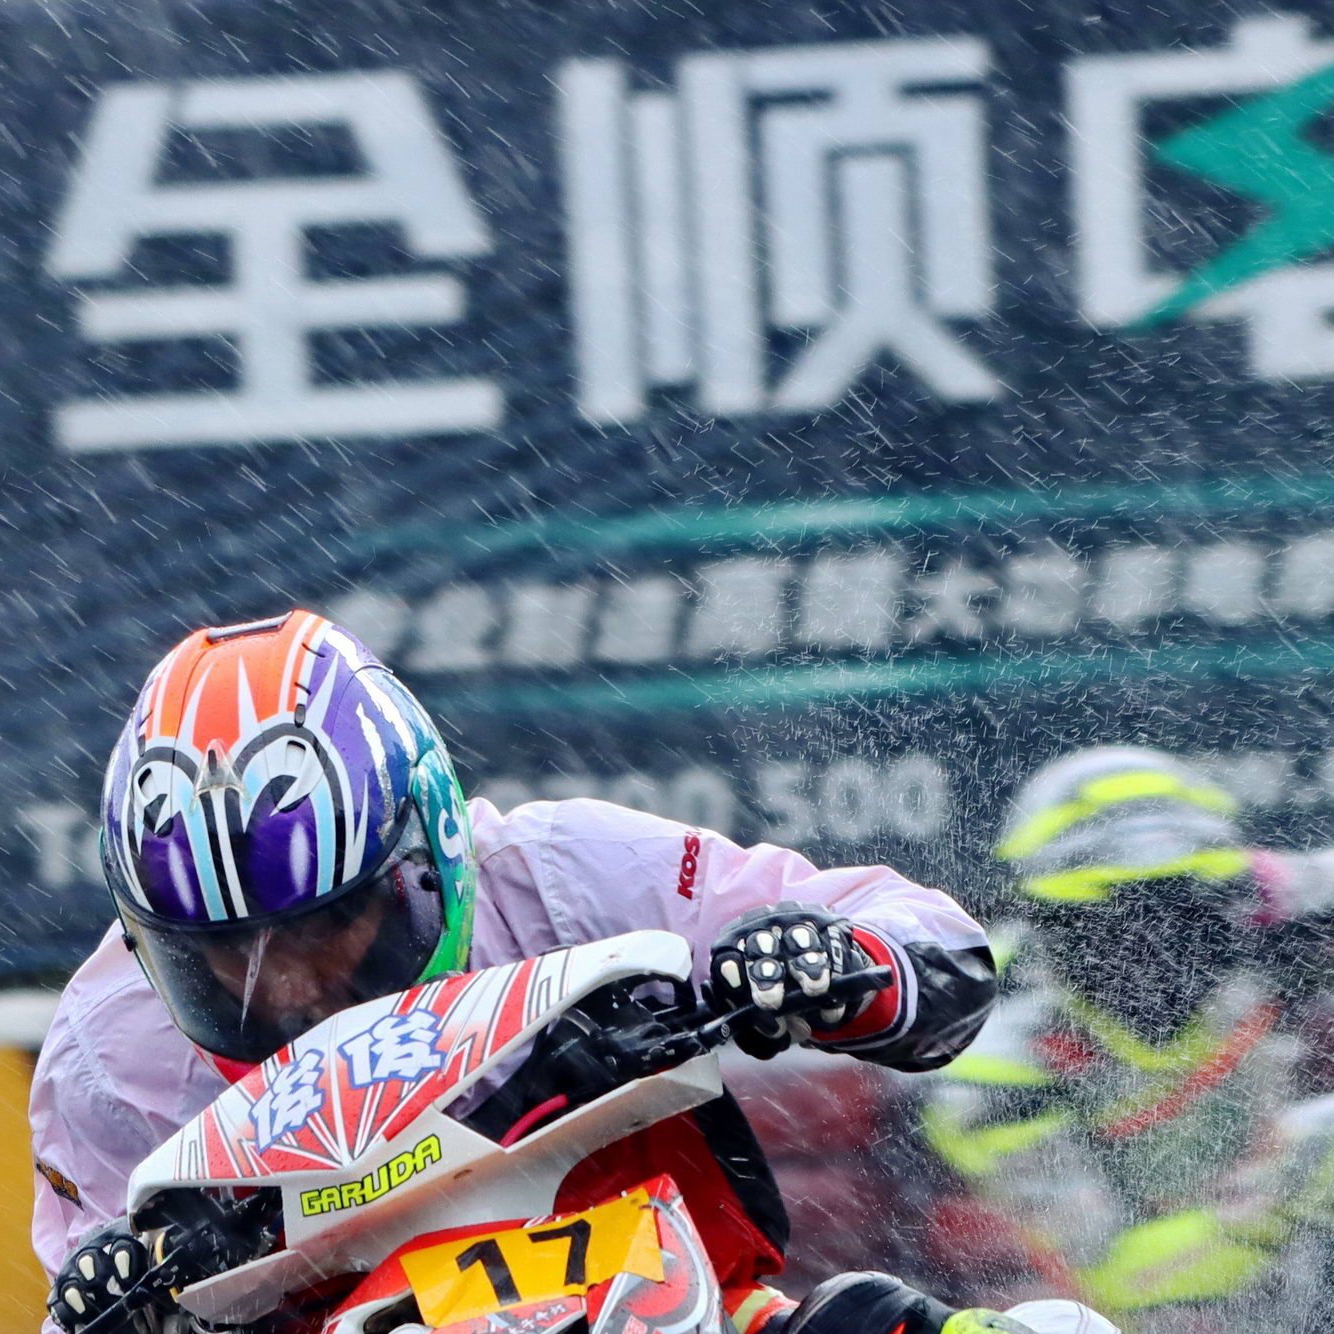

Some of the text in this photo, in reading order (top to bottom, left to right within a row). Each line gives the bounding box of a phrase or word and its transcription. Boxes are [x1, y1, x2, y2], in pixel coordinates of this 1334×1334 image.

[760, 754, 948, 844] 500
[677, 829, 703, 900] KOS
[300, 1133, 442, 1217] GARUDA
[455, 1218, 592, 1307] 17
